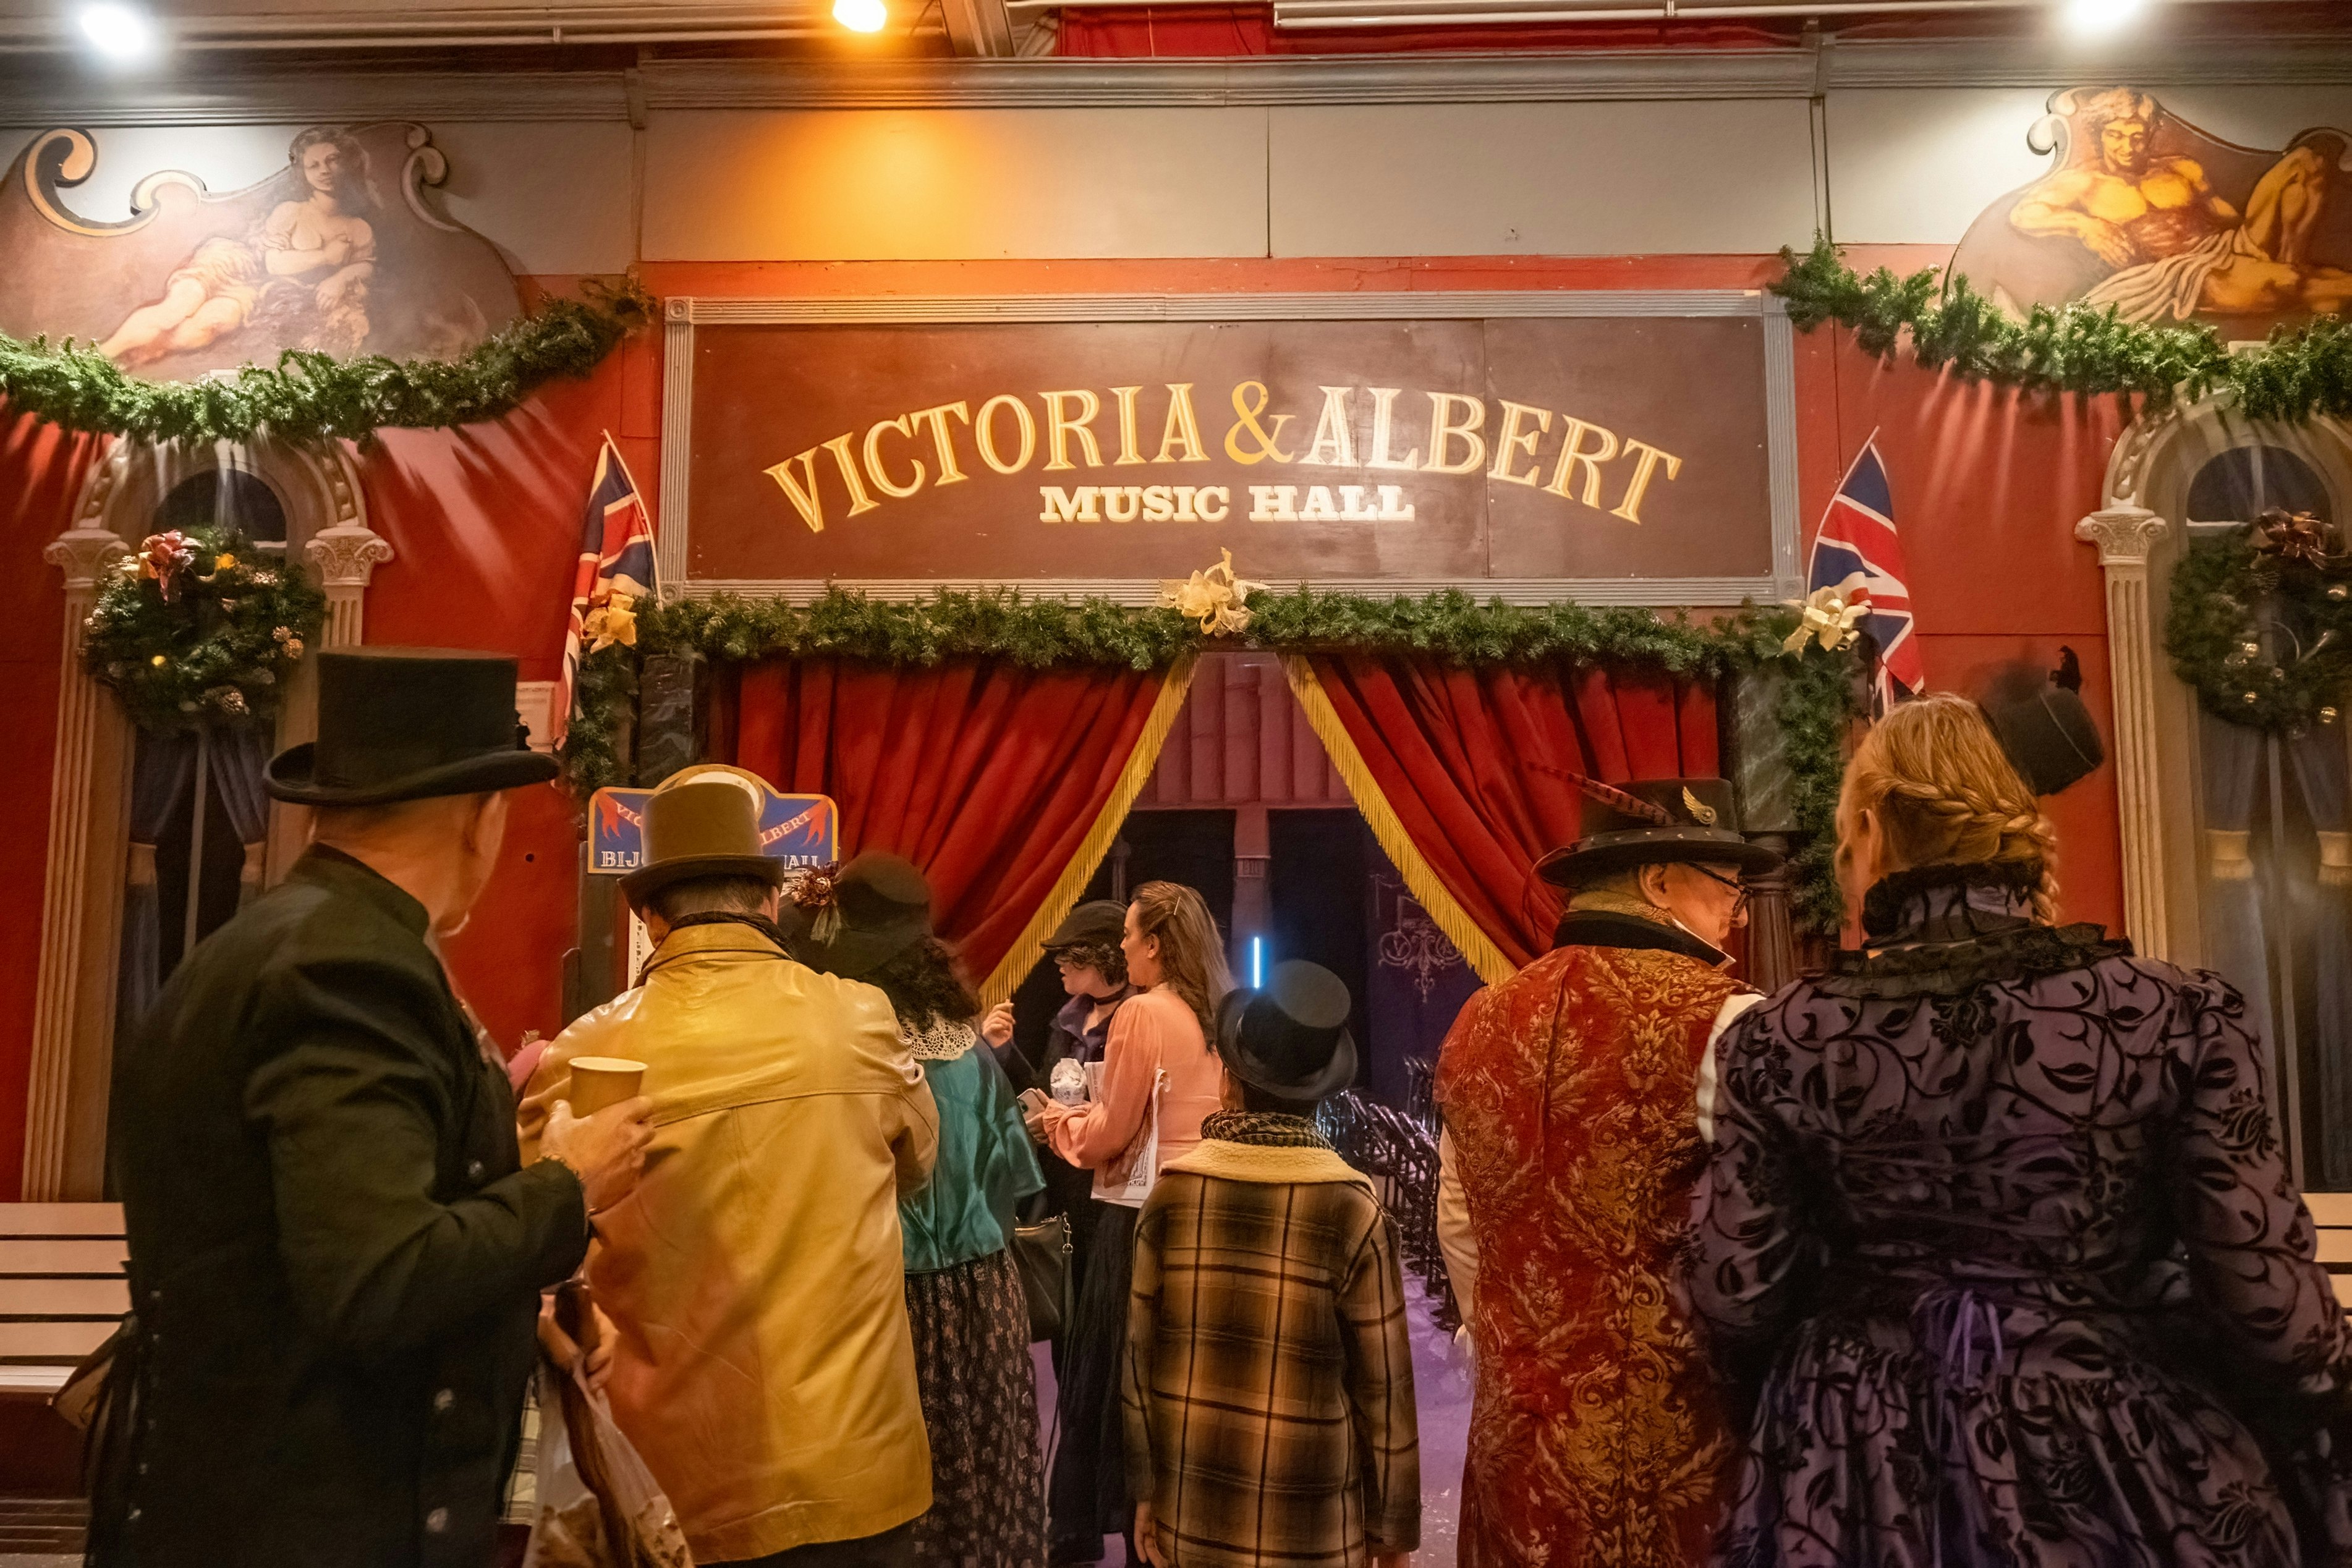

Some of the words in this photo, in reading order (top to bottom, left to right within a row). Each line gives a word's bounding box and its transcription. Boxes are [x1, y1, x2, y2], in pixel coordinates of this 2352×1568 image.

[762, 383, 1212, 533] VICTORIA
[1223, 380, 1296, 465] &
[1297, 385, 1683, 525] ALBERT
[1039, 486, 1229, 523] MUSIC
[1248, 485, 1415, 522] HALL
[759, 812, 811, 845] LBERT
[601, 850, 643, 867] BIJ
